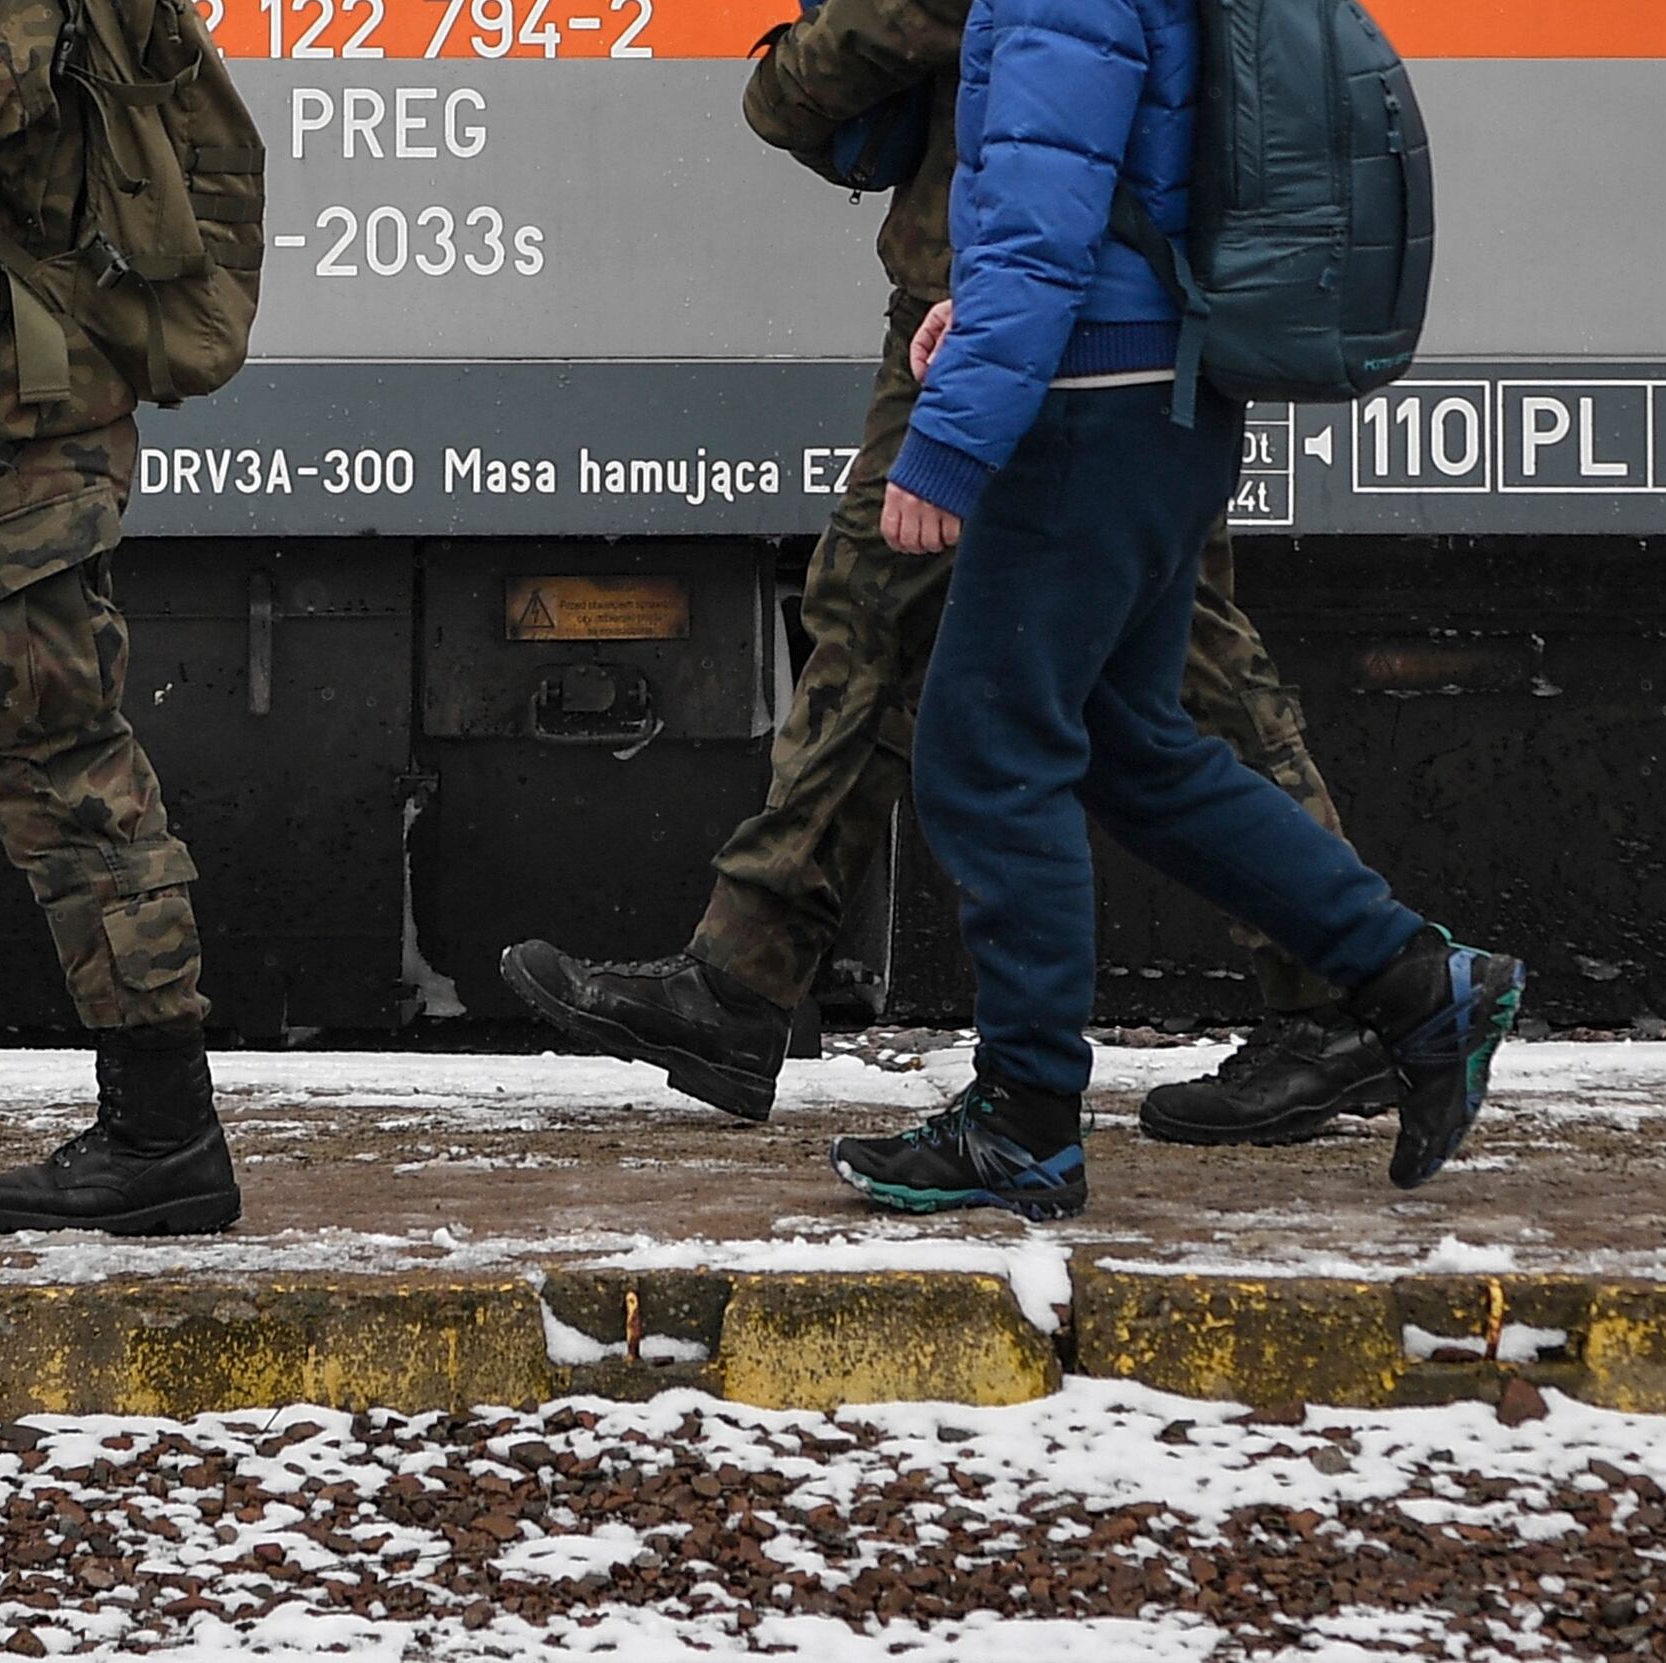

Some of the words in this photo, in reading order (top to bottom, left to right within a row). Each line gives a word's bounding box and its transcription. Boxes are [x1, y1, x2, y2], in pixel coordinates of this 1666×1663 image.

[291, 88, 487, 159] PREG
[1362, 396, 1480, 477] 110
[1521, 396, 1629, 477] PL
[139, 447, 415, 495] DRV3A-300
[443, 447, 557, 494] Masa
[579, 447, 780, 505] hamująca
